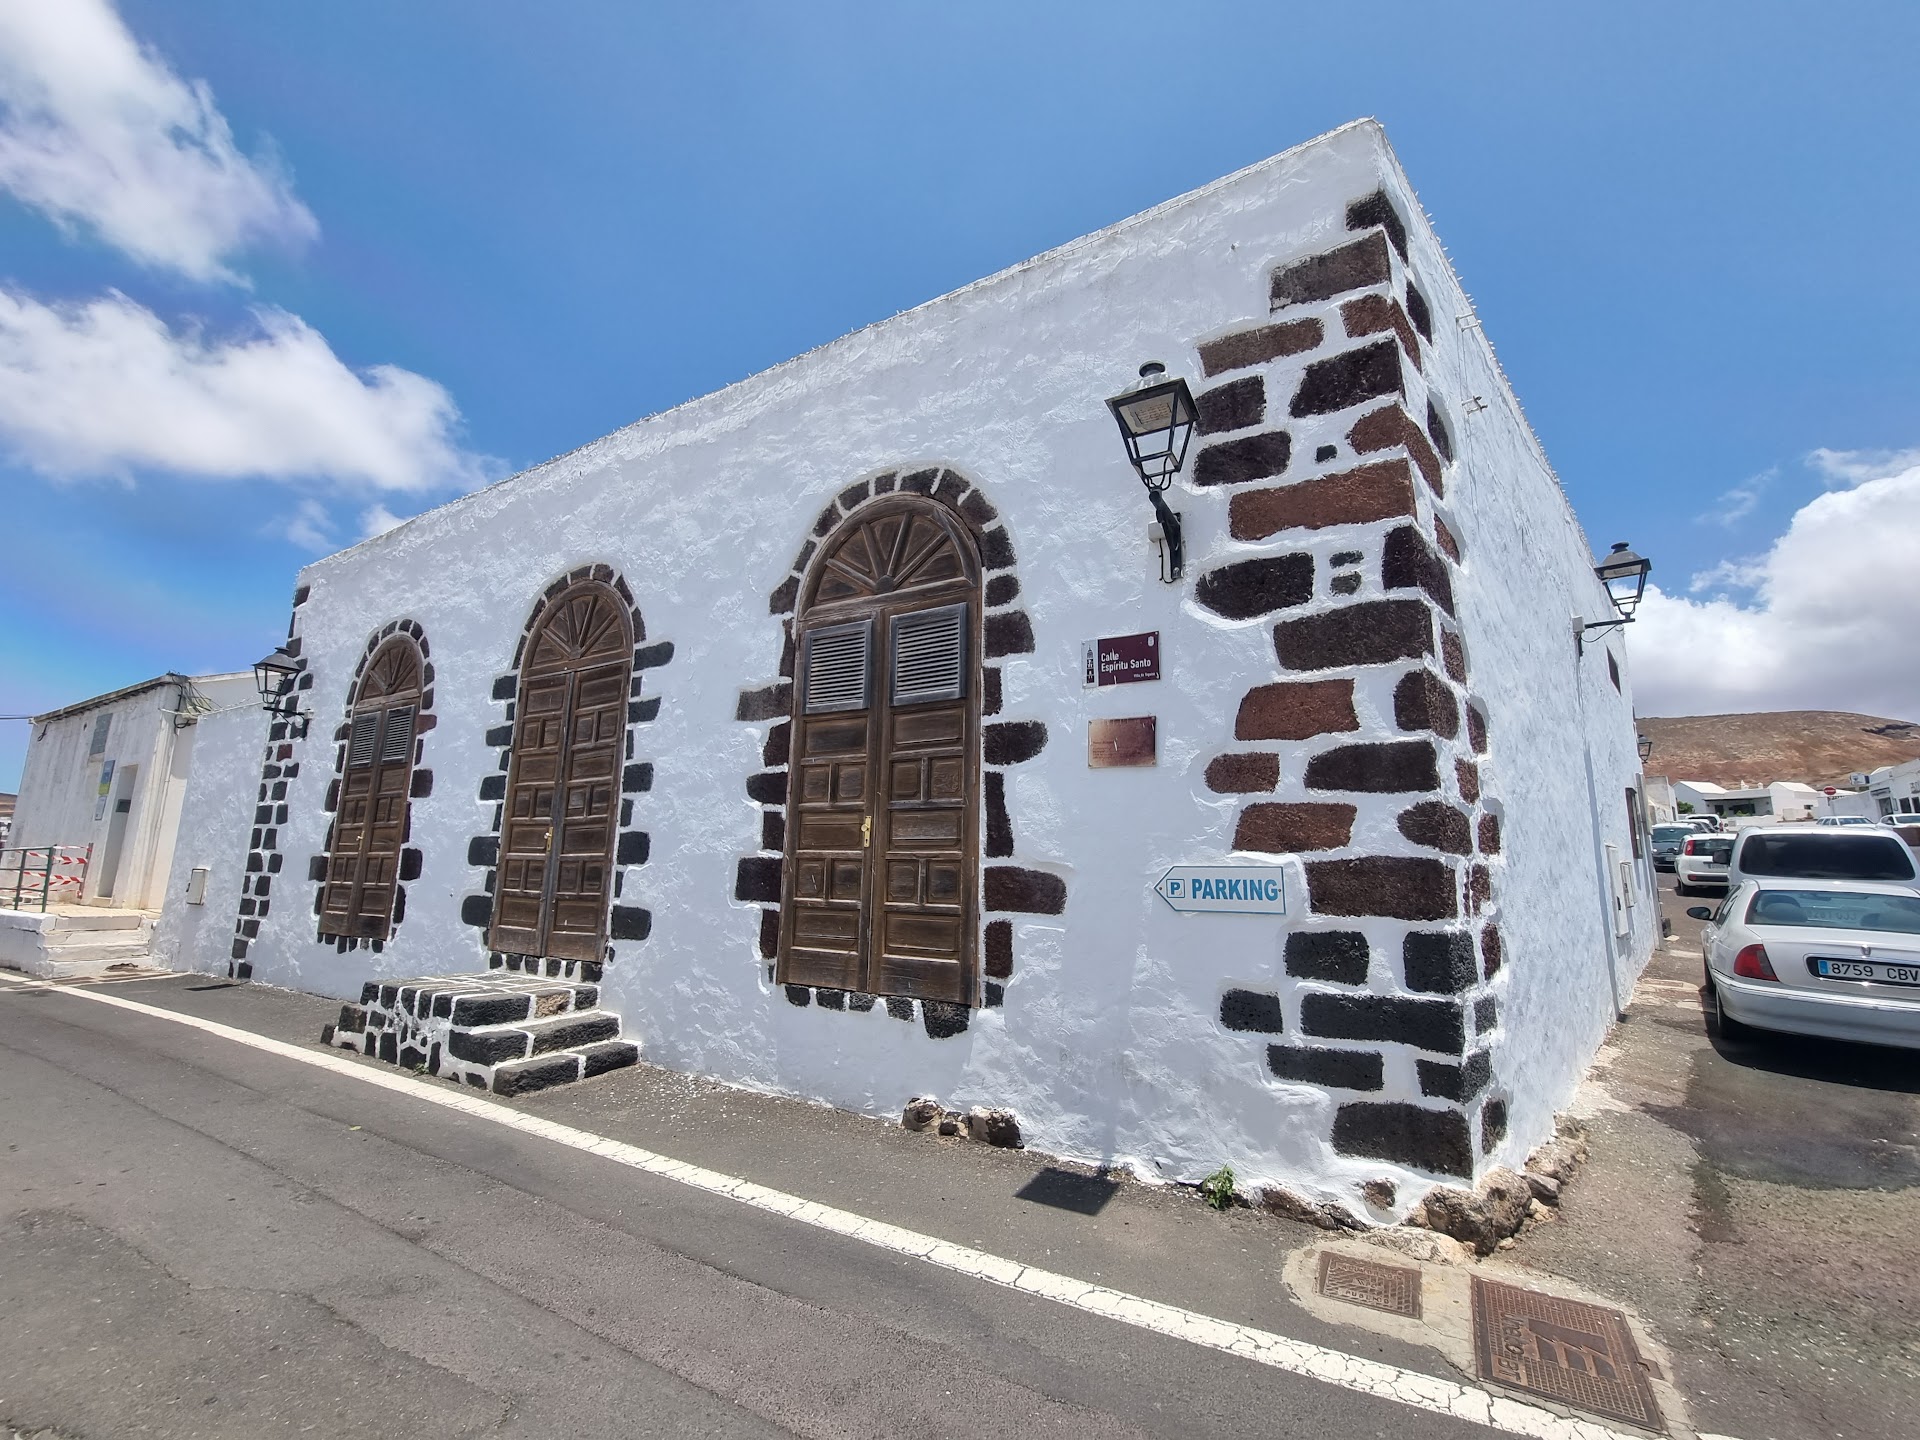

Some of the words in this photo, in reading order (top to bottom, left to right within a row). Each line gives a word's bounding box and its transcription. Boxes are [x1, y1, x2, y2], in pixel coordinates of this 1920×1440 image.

[1101, 651, 1120, 662] Calle
[1101, 661, 1128, 673] Espíritu
[1130, 658, 1151, 669] Santo
[1170, 882, 1181, 895] P
[1191, 878, 1278, 901] PARKING
[1831, 963, 1874, 977] 8759
[1887, 967, 1918, 982] CBV
